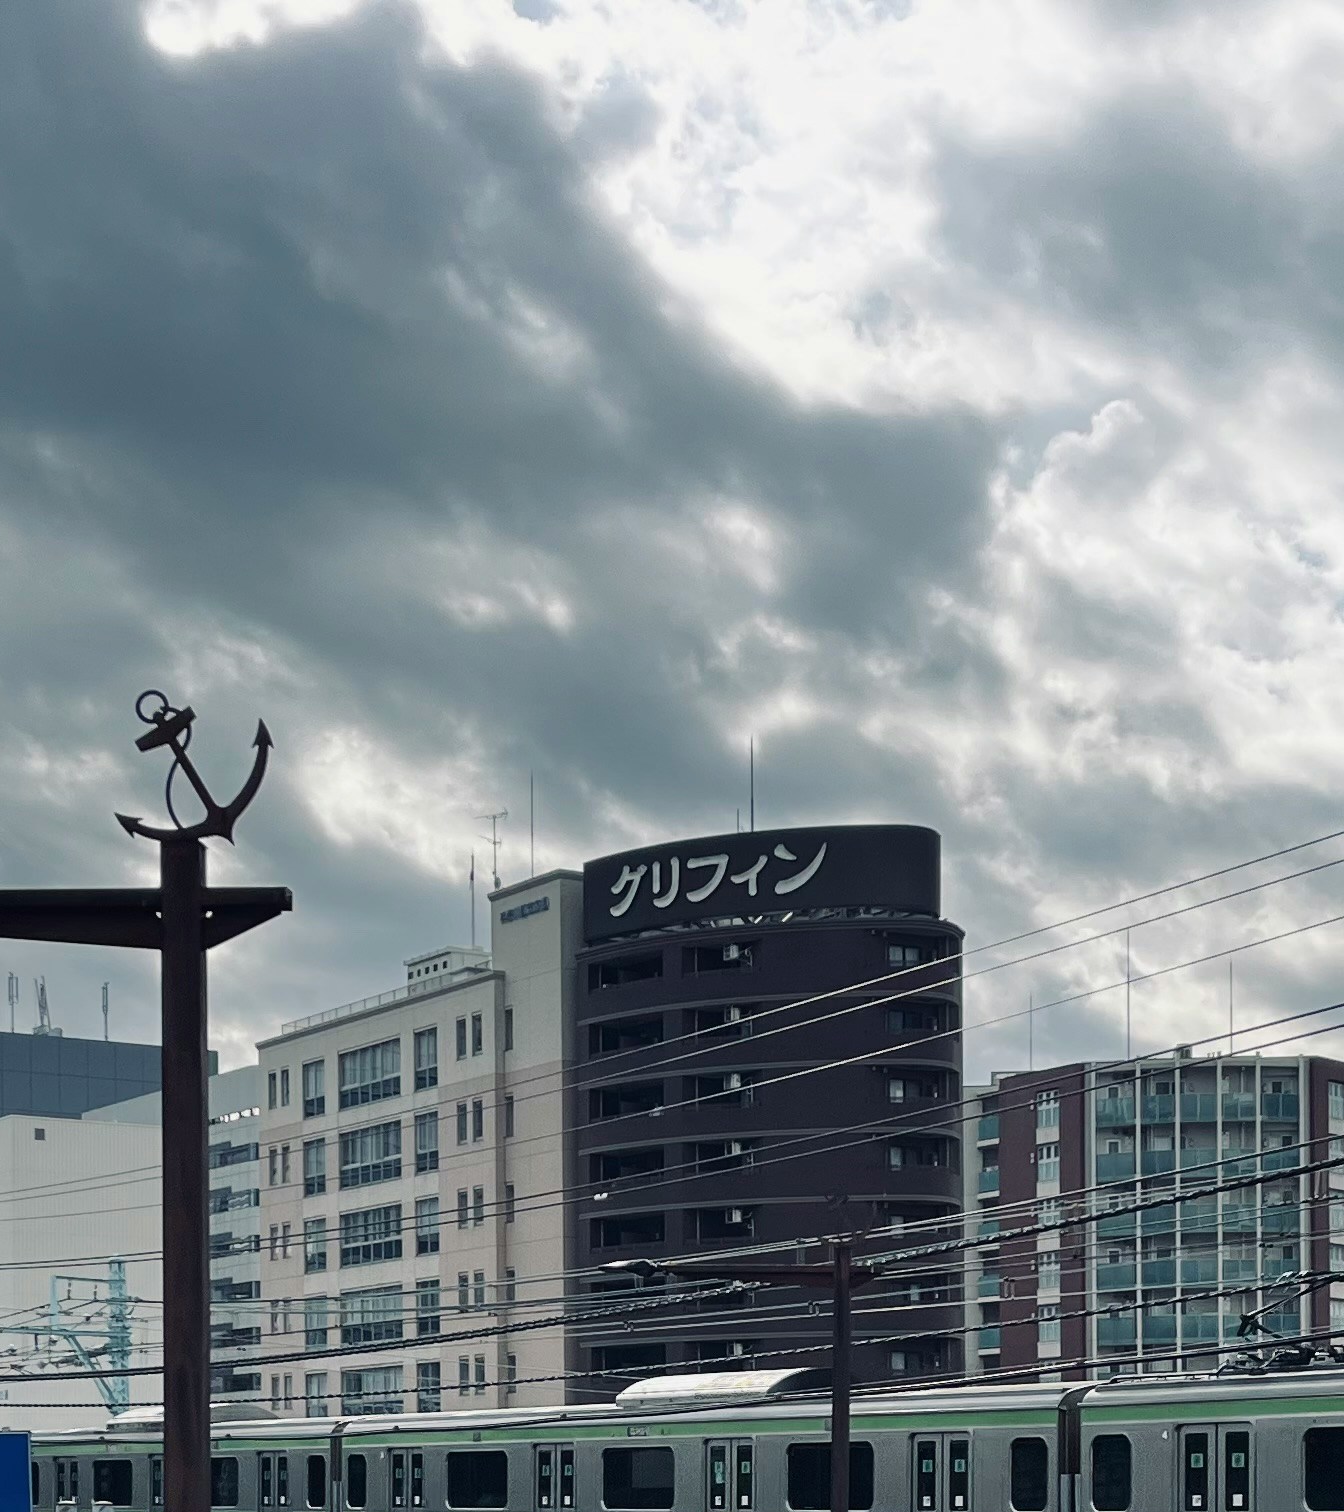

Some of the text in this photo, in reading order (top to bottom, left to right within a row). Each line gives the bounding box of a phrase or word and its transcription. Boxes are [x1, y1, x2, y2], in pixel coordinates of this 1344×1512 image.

[610, 842, 827, 917] グリフィン
